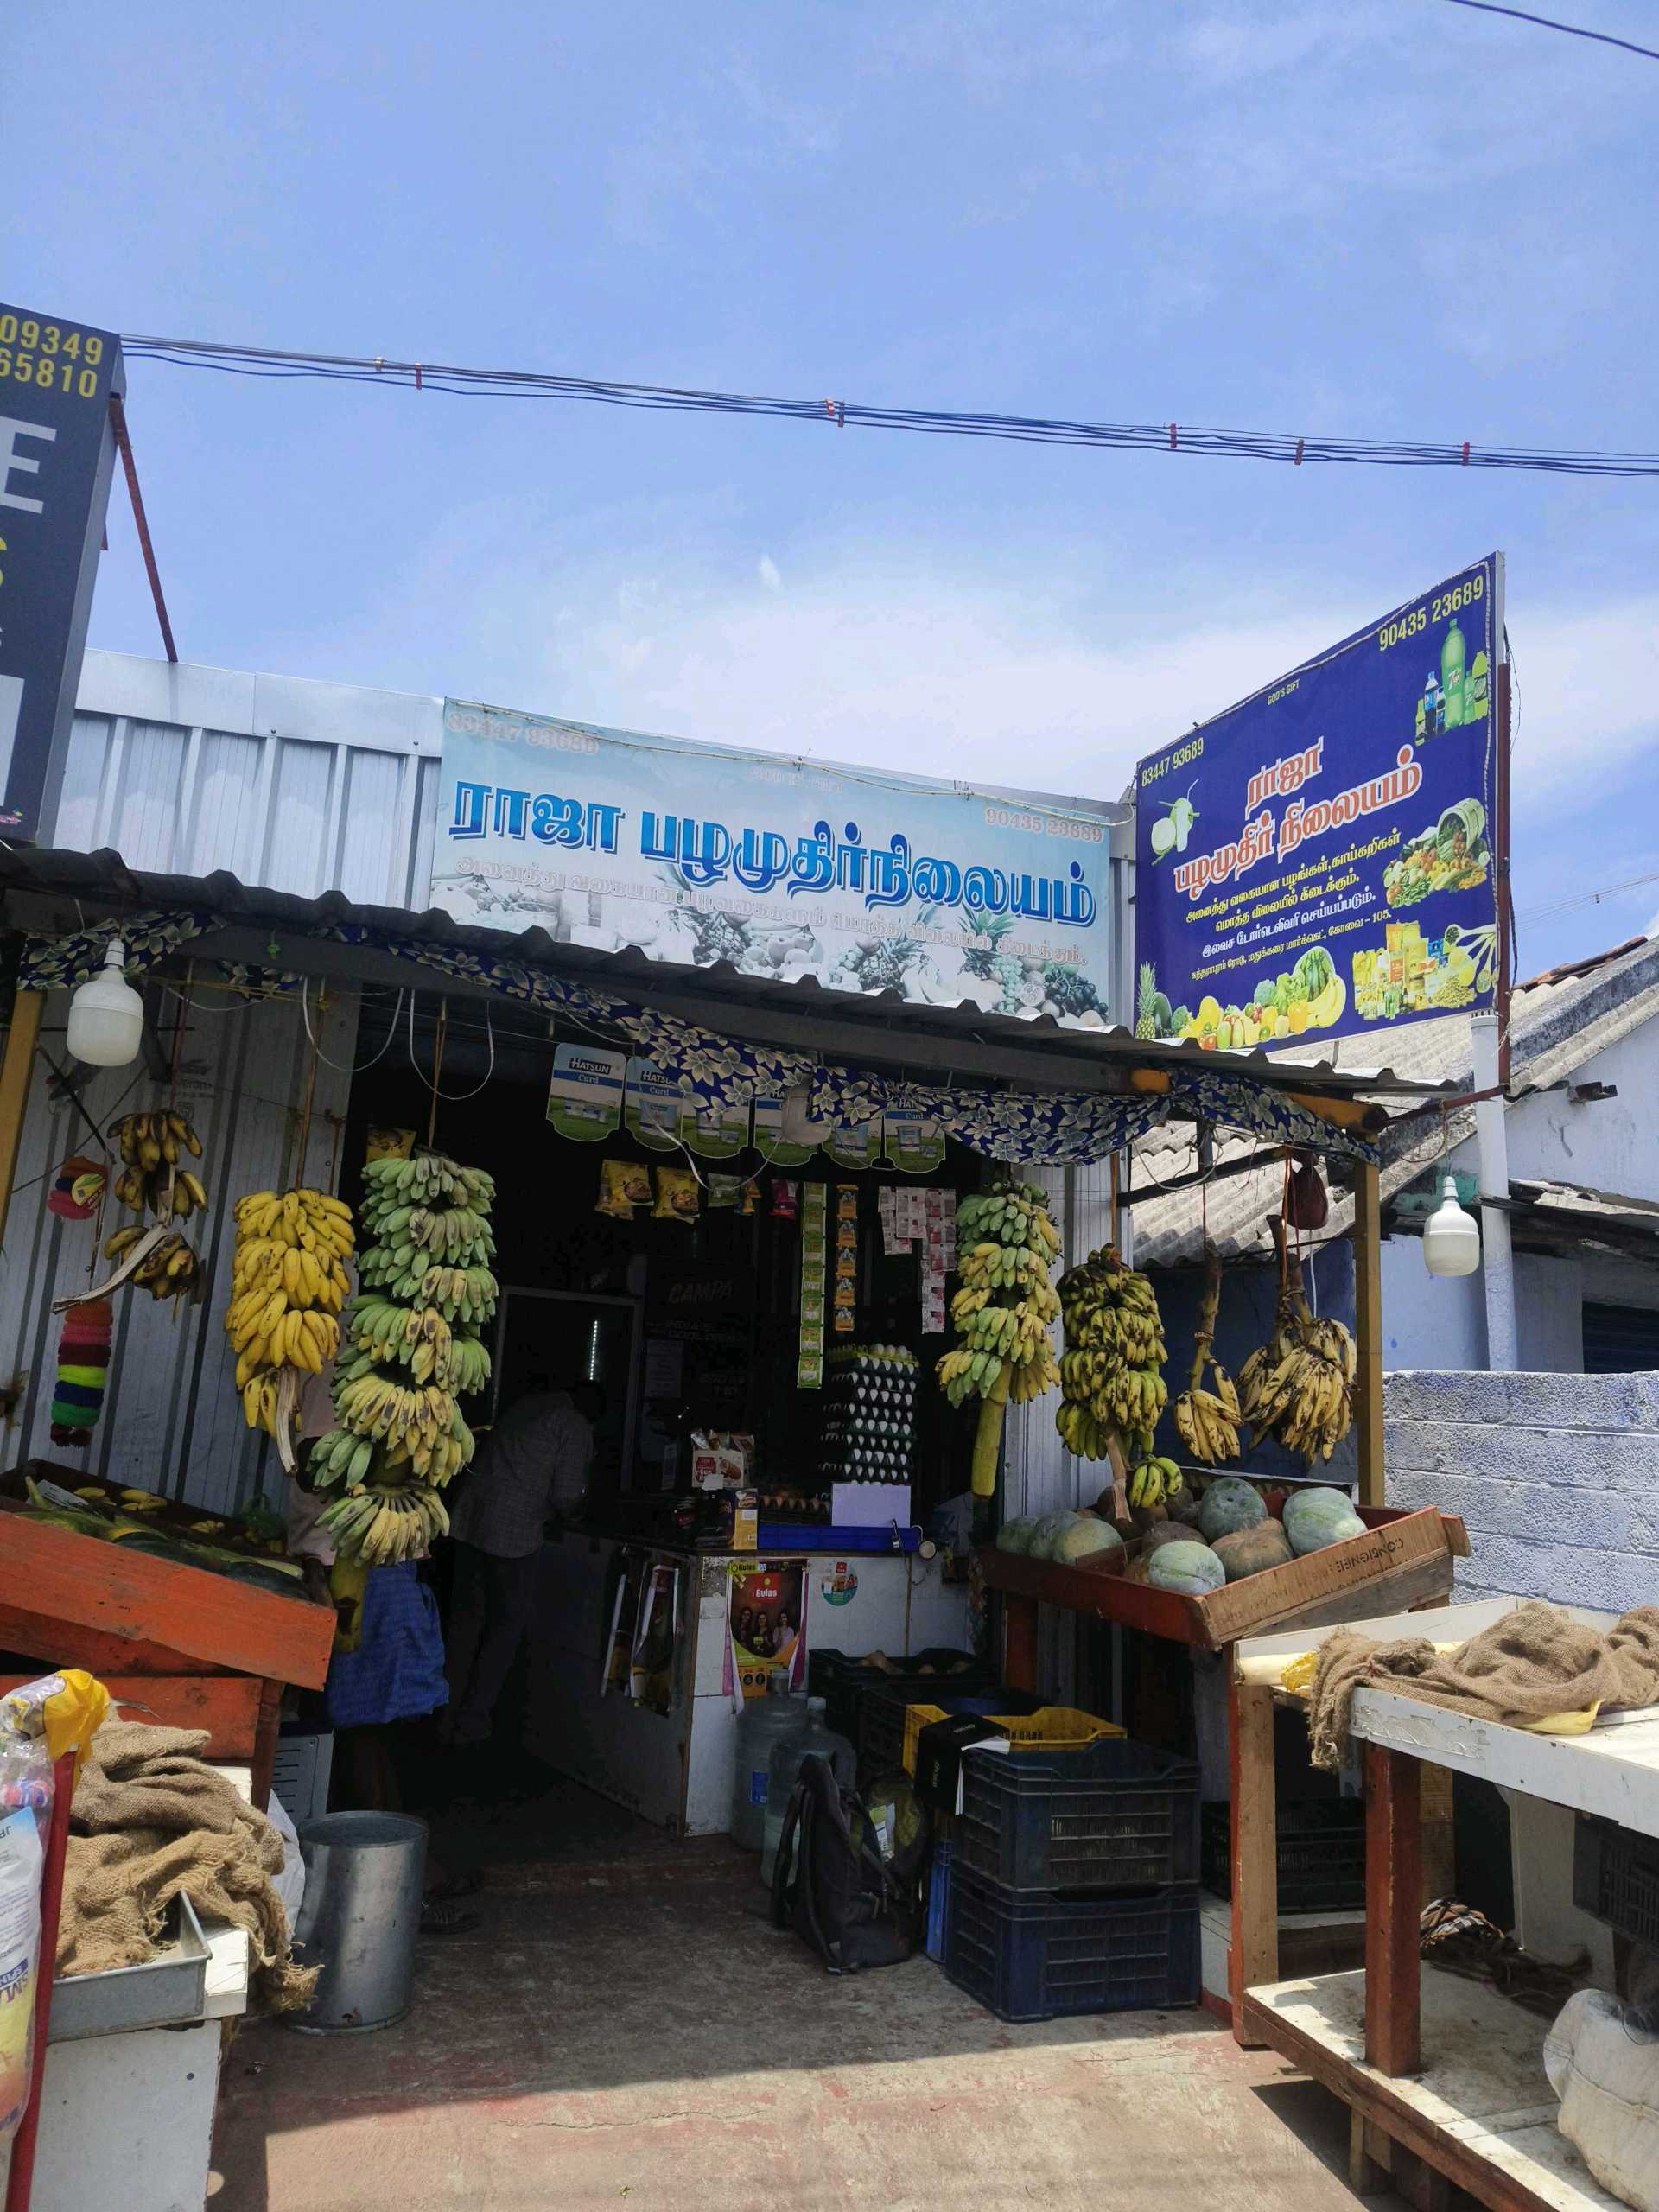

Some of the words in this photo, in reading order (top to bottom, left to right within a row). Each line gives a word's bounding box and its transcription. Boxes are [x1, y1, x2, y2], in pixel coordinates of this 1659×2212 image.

[0, 315, 103, 365] 09349
[1380, 607, 1426, 651] 90435
[1432, 575, 1484, 622] 23689
[1141, 756, 1171, 787] 83447
[1173, 737, 1204, 769] 93689
[1245, 736, 1324, 820] ராஜா
[449, 780, 626, 855] ராஜா
[985, 807, 1043, 835] 90435
[1046, 819, 1104, 844] 23689
[1186, 897, 1229, 923] அனைத்து
[1230, 879, 1280, 906] வகையான
[1216, 908, 1249, 932] மொத்த
[1251, 888, 1298, 919] விலையில்
[1203, 938, 1235, 958] இலவச
[570, 1058, 610, 1074] HATSUN
[578, 1074, 599, 1084] Curd
[650, 1086, 670, 1096] Curd
